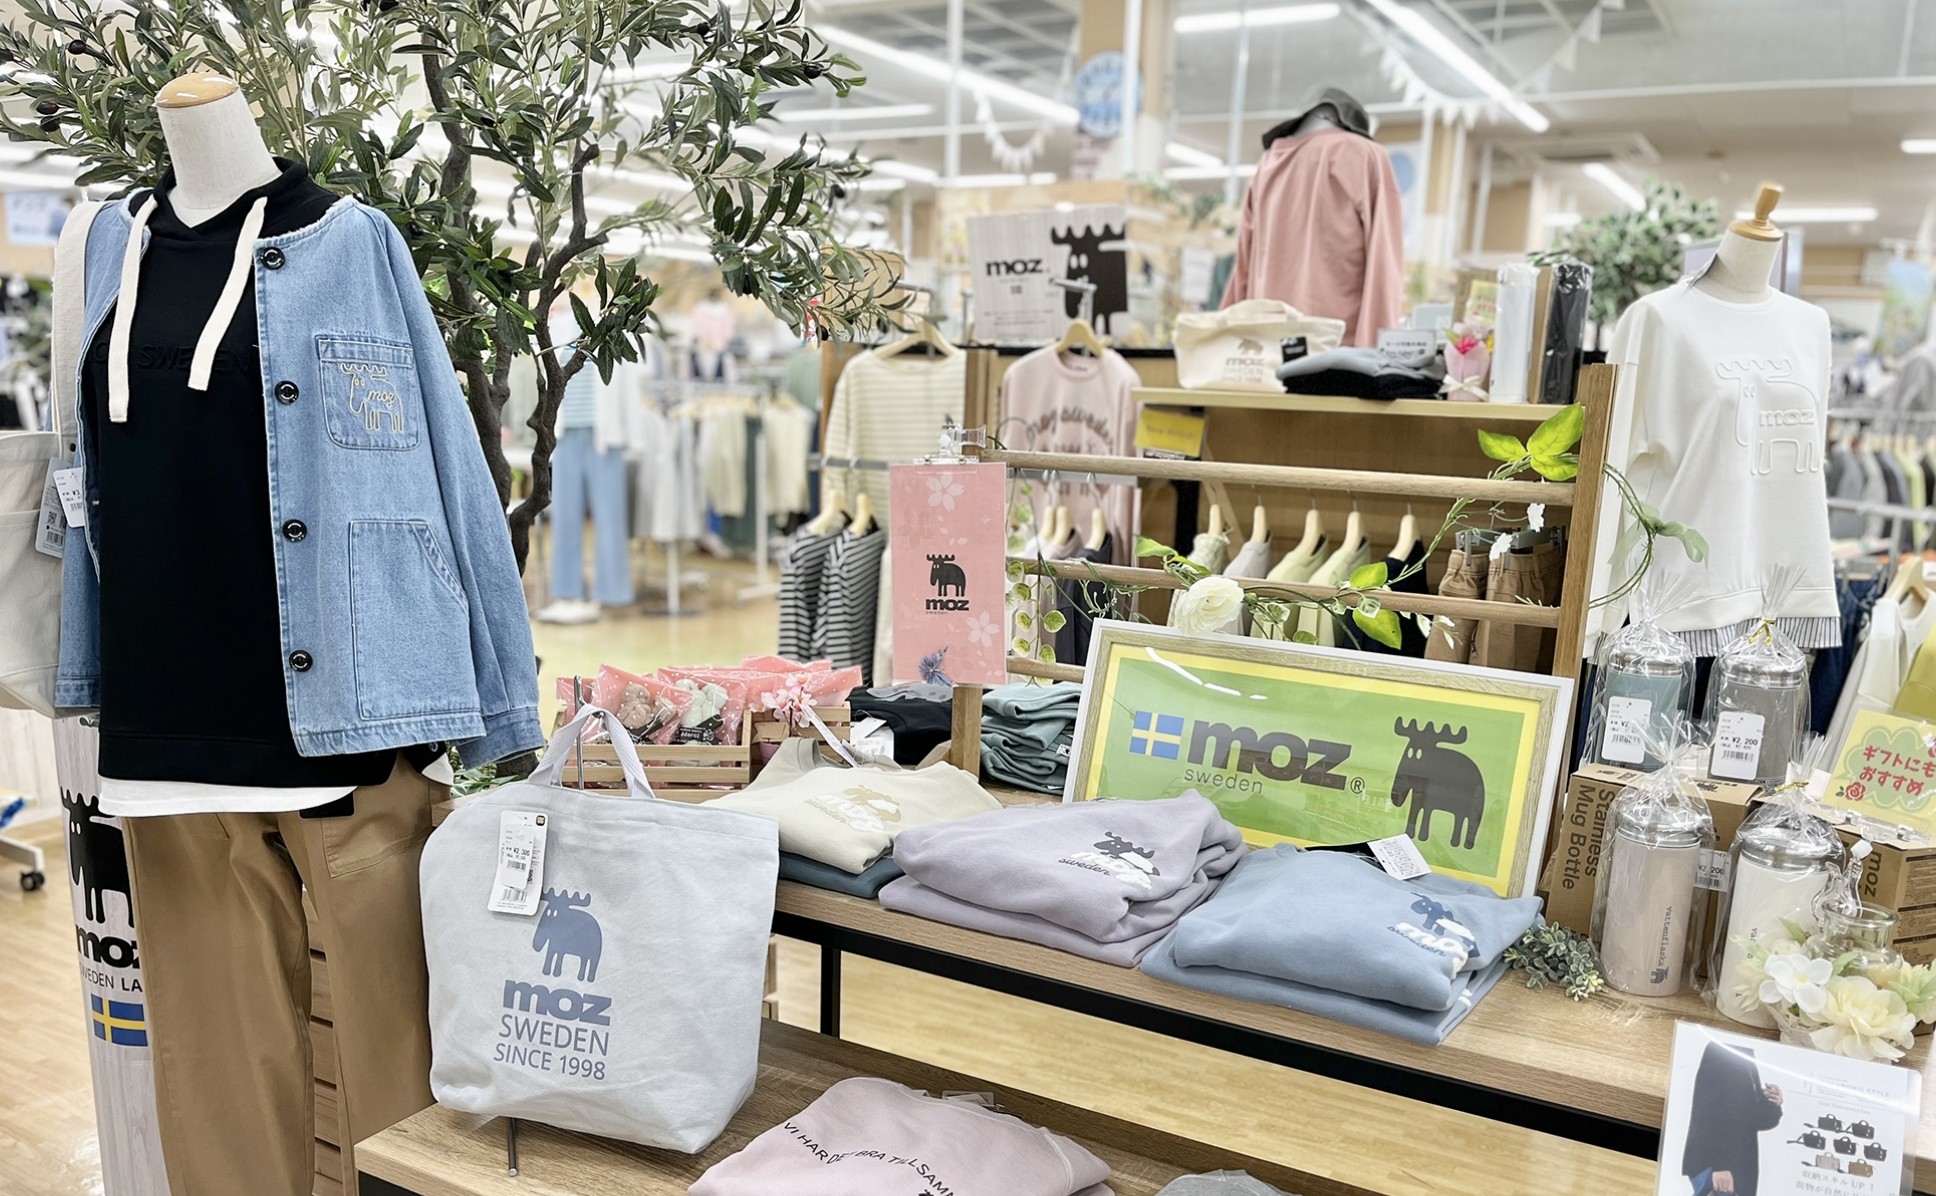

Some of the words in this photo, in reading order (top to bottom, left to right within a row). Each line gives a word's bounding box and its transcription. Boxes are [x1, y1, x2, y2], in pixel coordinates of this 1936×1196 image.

[986, 258, 1044, 277] moz
[137, 345, 252, 376] SWEEN
[367, 391, 396, 410] moz
[1759, 409, 1815, 427] moz
[926, 599, 970, 611] moz
[1863, 745, 1936, 778] ギフトにも
[1184, 768, 1263, 795] sweden
[1859, 766, 1924, 796] おすすめ
[1570, 784, 1596, 828] Mug
[1584, 788, 1615, 877] Stainless
[1058, 858, 1111, 876] sweden
[1562, 832, 1587, 890] Bottle
[1864, 851, 1882, 897] moz
[1658, 906, 1672, 967] vattenflaska
[503, 979, 612, 1027] moz
[498, 1013, 610, 1057] SWEDEN
[493, 1042, 553, 1072] SINCE
[559, 1055, 606, 1081] 1998
[784, 1122, 800, 1134] VI
[797, 1134, 829, 1161] HAR
[855, 1150, 886, 1160] BRA
